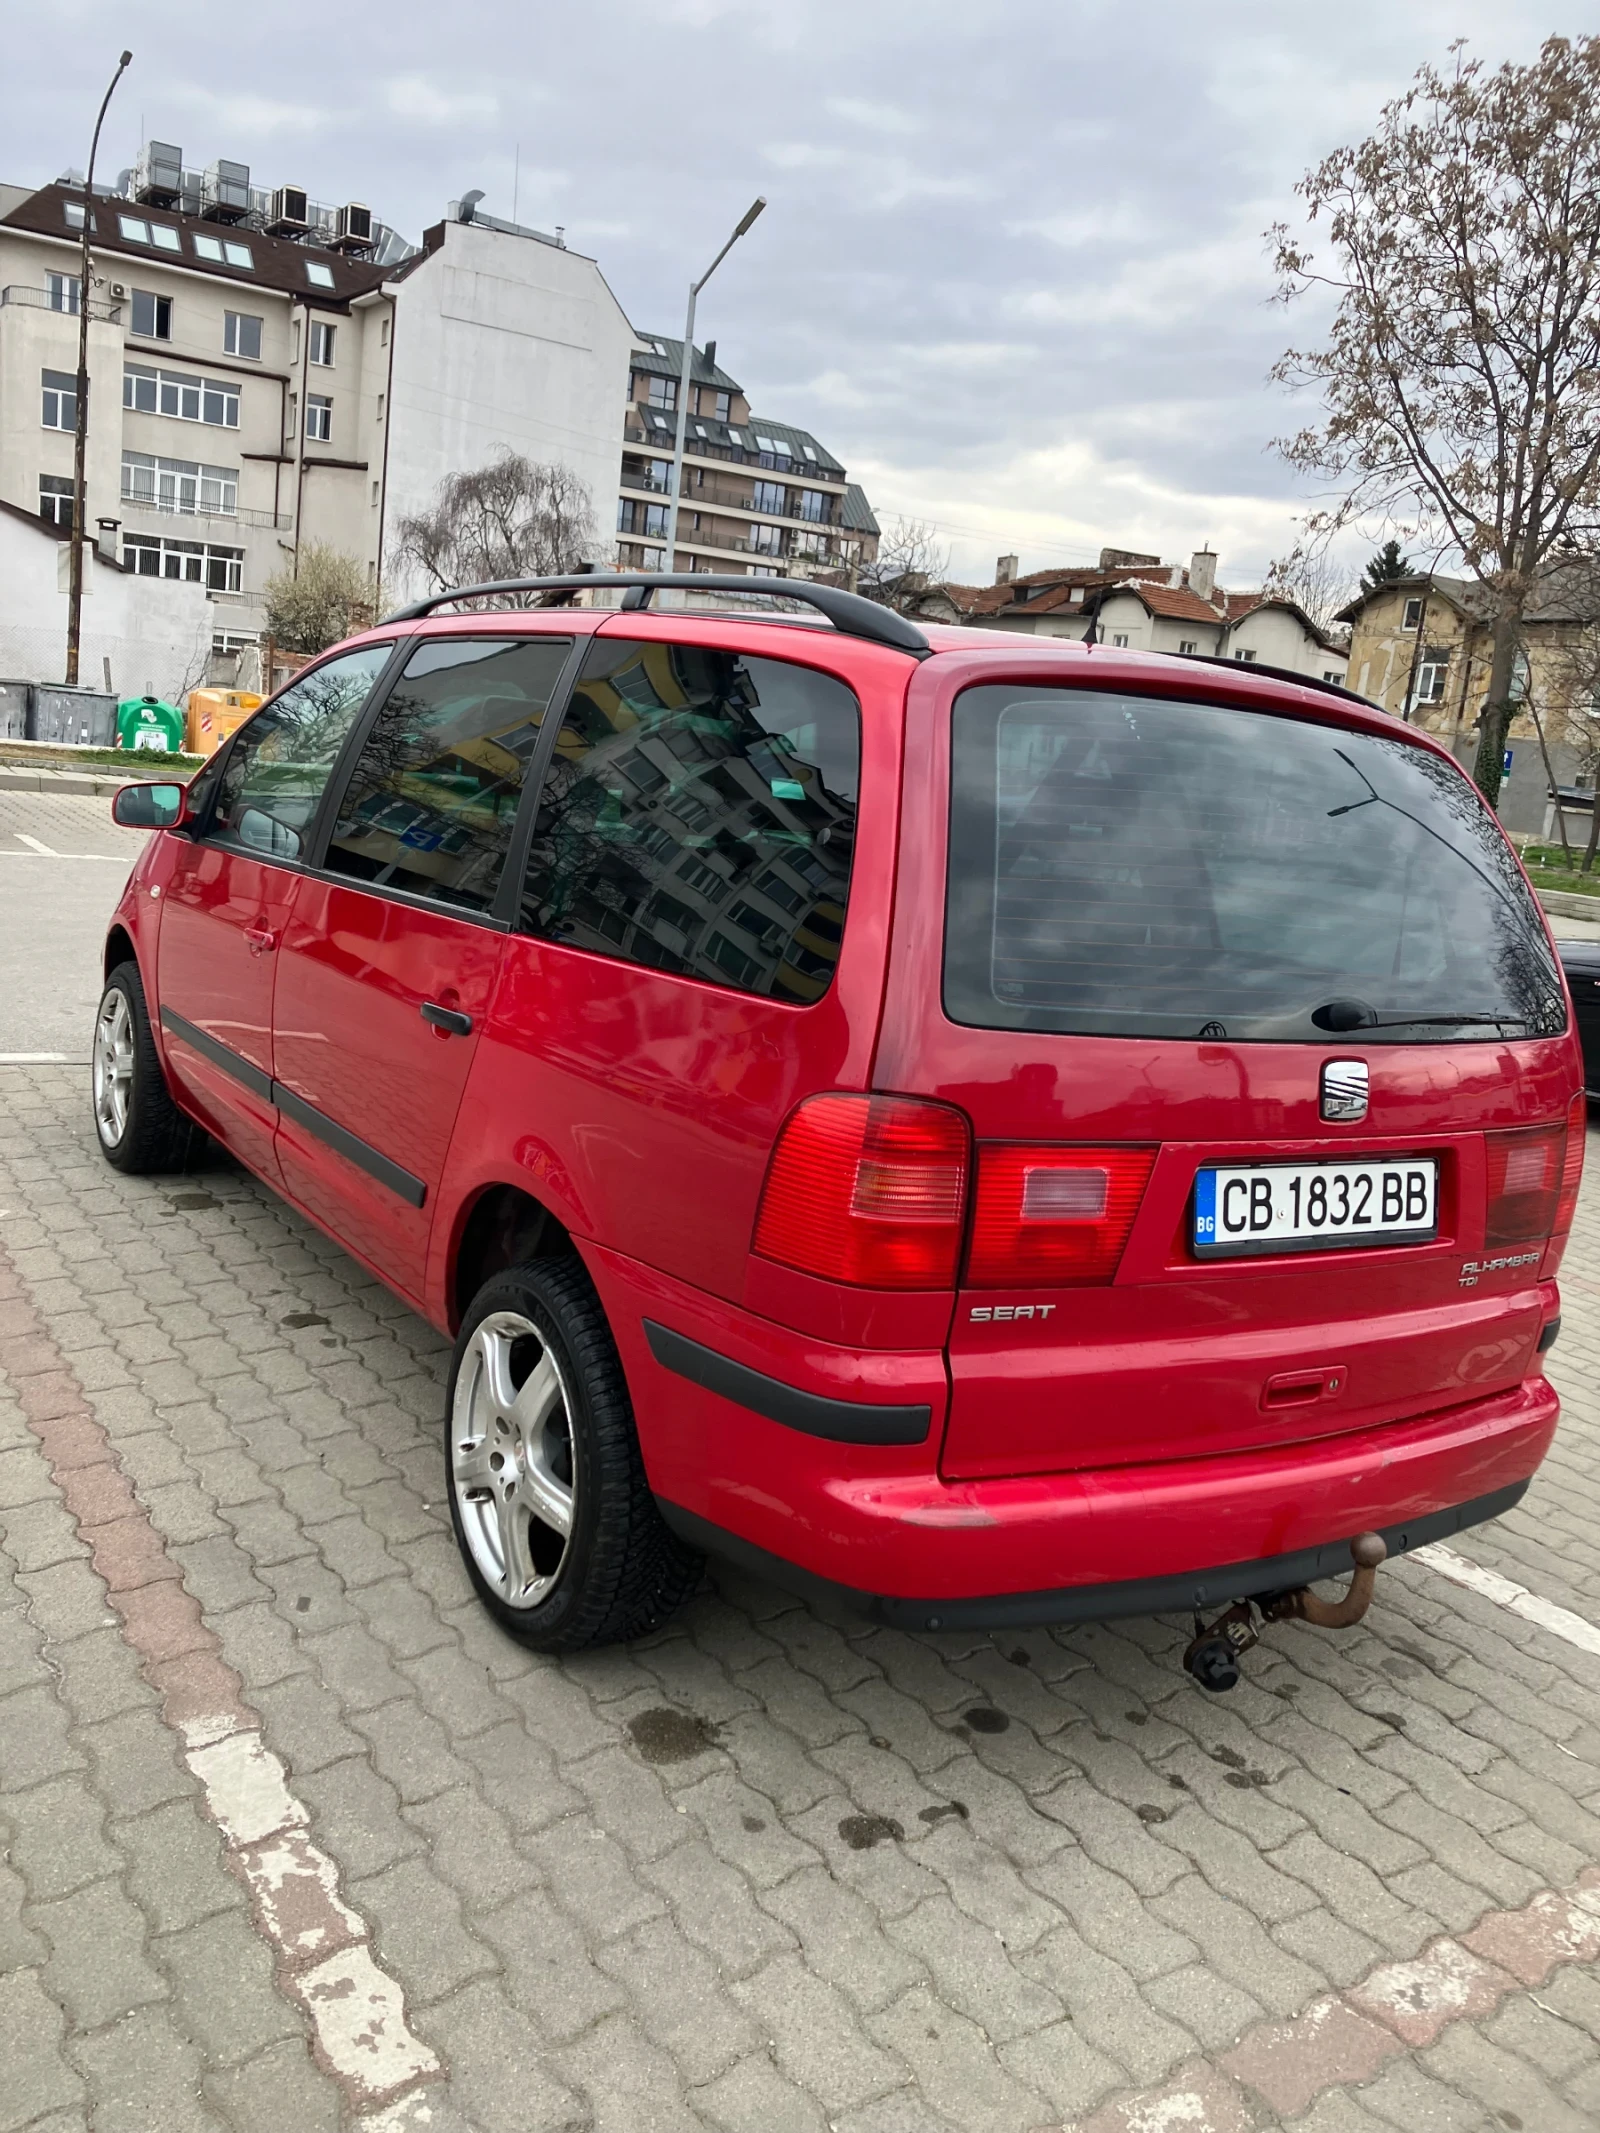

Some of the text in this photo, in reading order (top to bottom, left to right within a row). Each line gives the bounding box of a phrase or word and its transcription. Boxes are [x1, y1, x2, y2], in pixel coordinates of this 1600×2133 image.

[1223, 1171, 1427, 1232] CB 1832 BB
[1197, 1216, 1214, 1233] BG
[1460, 1252, 1541, 1276] ALHAMBRA
[1458, 1276, 1478, 1288] TDI
[969, 1304, 1056, 1322] SEAT
